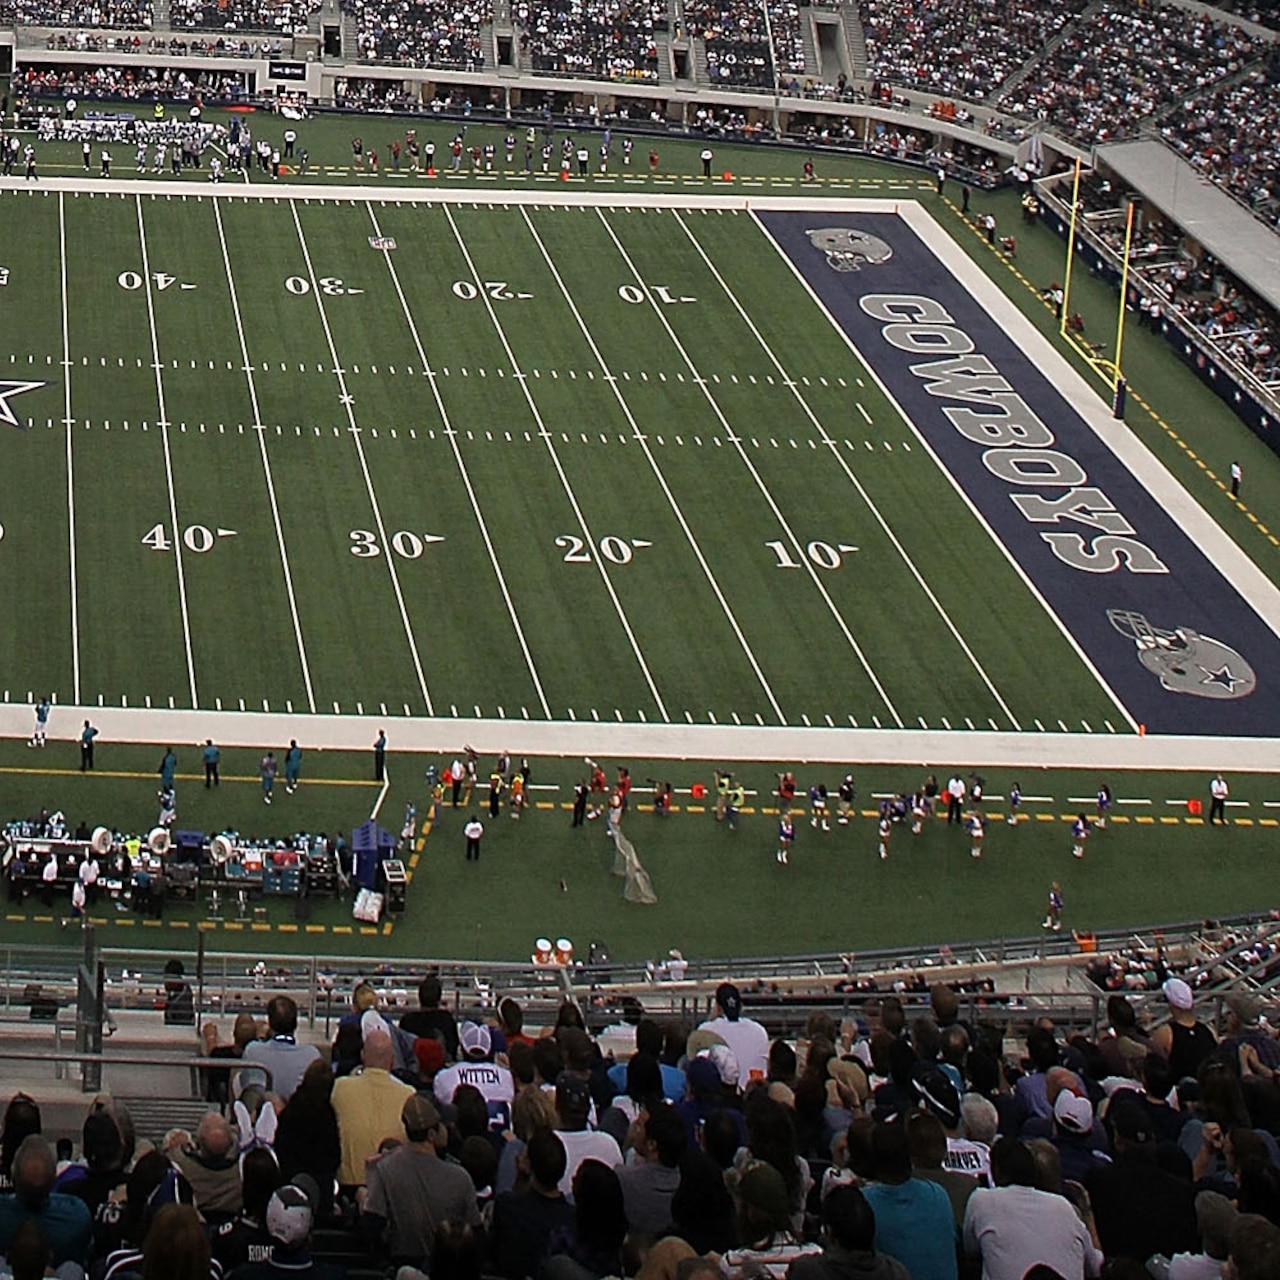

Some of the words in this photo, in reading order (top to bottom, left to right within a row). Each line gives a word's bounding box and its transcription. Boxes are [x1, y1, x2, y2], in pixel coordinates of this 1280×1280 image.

[859, 293, 1170, 575] COWBOYS
[141, 524, 215, 553] 40
[348, 530, 425, 560] 30
[554, 535, 634, 565] 20
[764, 541, 842, 570] 10
[457, 1069, 500, 1085] WITTEN
